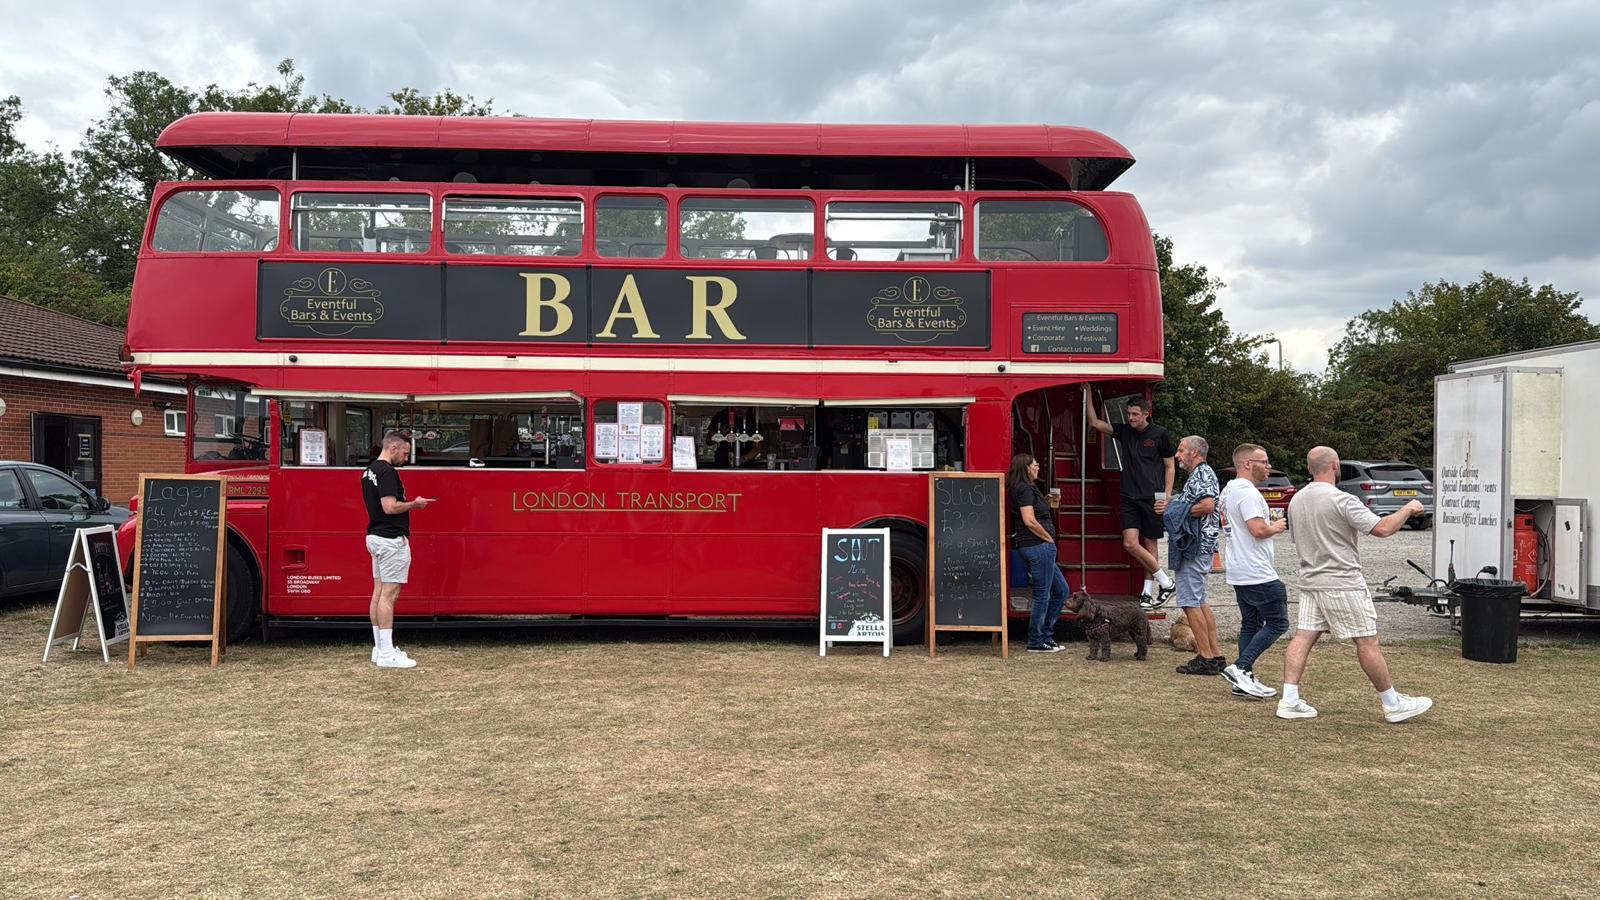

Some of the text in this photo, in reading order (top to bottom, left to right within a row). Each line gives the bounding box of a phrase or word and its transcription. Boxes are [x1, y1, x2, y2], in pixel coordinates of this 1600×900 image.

[327, 271, 338, 293] E
[912, 280, 922, 302] E
[307, 299, 357, 310] Eventful
[518, 272, 747, 340] BAR
[290, 310, 373, 321] Bars & Events
[894, 306, 941, 318] Eventful
[878, 318, 956, 330] Bars & Events
[1442, 466, 1478, 480] Outside Catering
[148, 480, 213, 507] Lager
[247, 486, 267, 494] 2293
[937, 480, 993, 506] Slush
[1442, 480, 1457, 494] Special
[1459, 480, 1480, 492] Functions
[512, 492, 742, 512] LONDON TRANSPORT
[1442, 496, 1480, 510] Contract Catering
[1478, 513, 1497, 526] Lunches
[834, 538, 880, 562] SHOT
